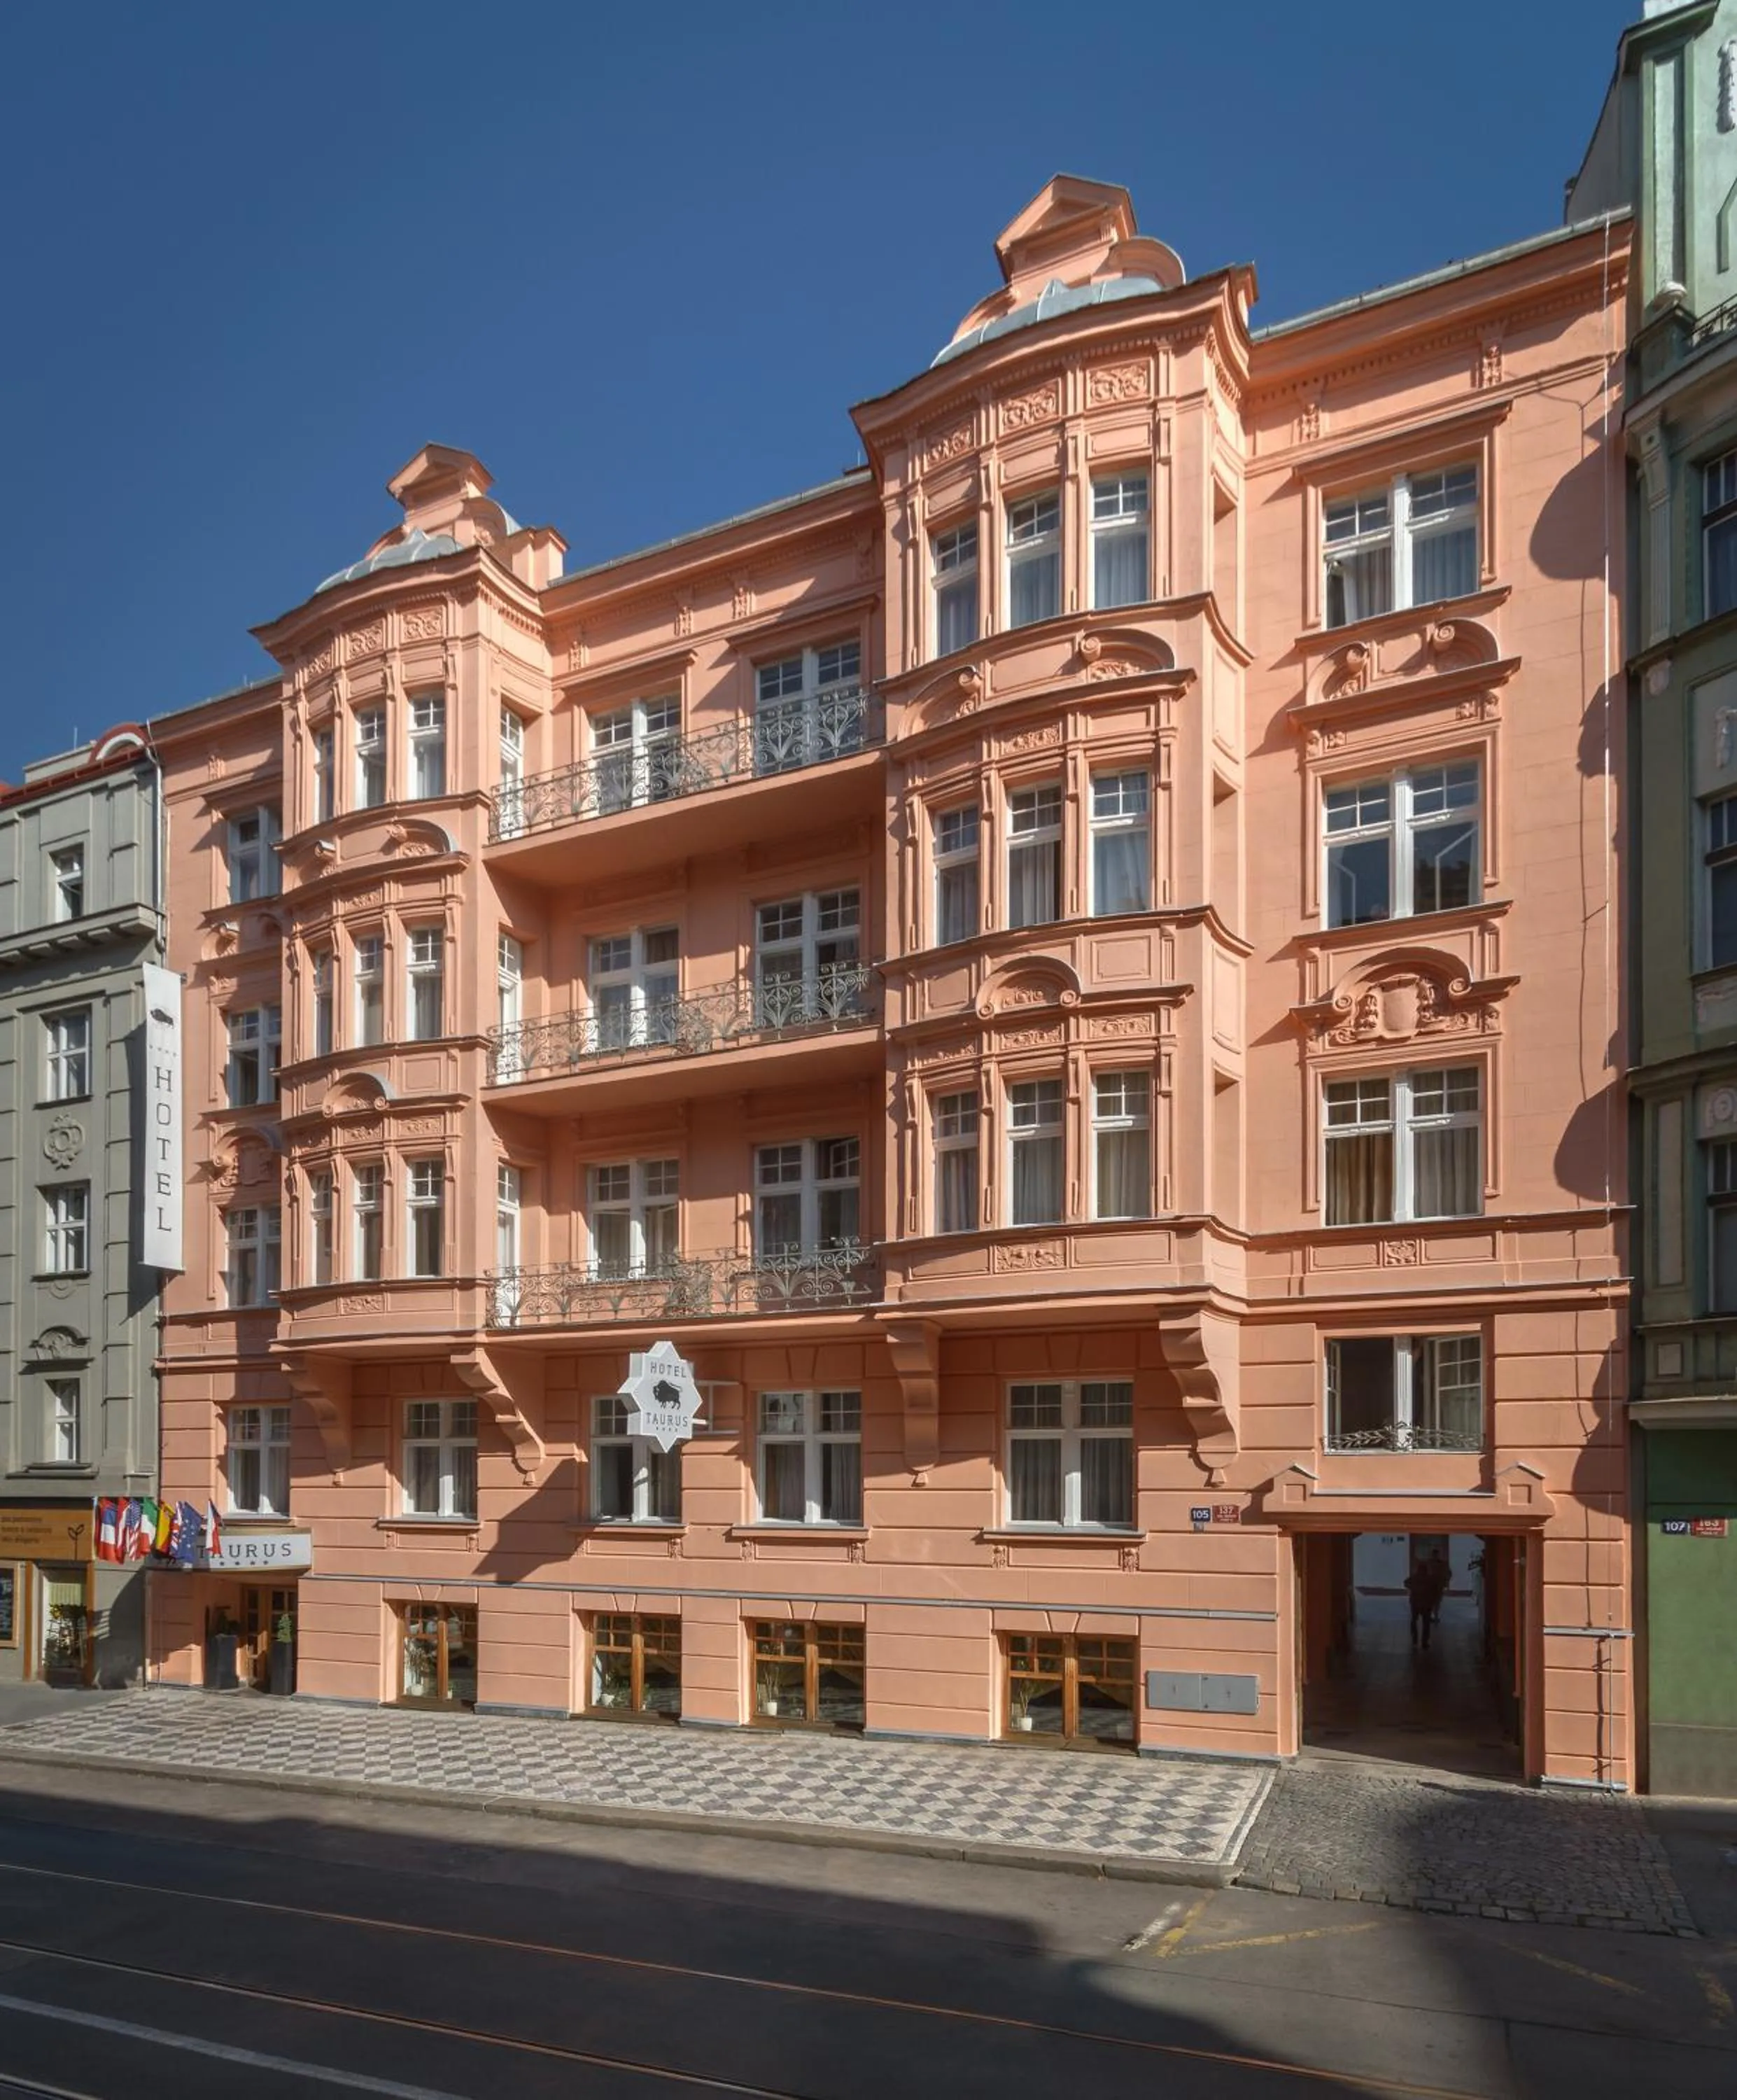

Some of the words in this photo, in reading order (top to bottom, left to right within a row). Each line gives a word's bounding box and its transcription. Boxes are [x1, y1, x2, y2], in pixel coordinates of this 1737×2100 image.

[155, 1066, 172, 1232] HOTEL
[650, 1361, 687, 1378] HOTEL
[645, 1412, 689, 1427] TAURUS
[1193, 1509, 1209, 1519] 105
[1665, 1521, 1686, 1532] 107
